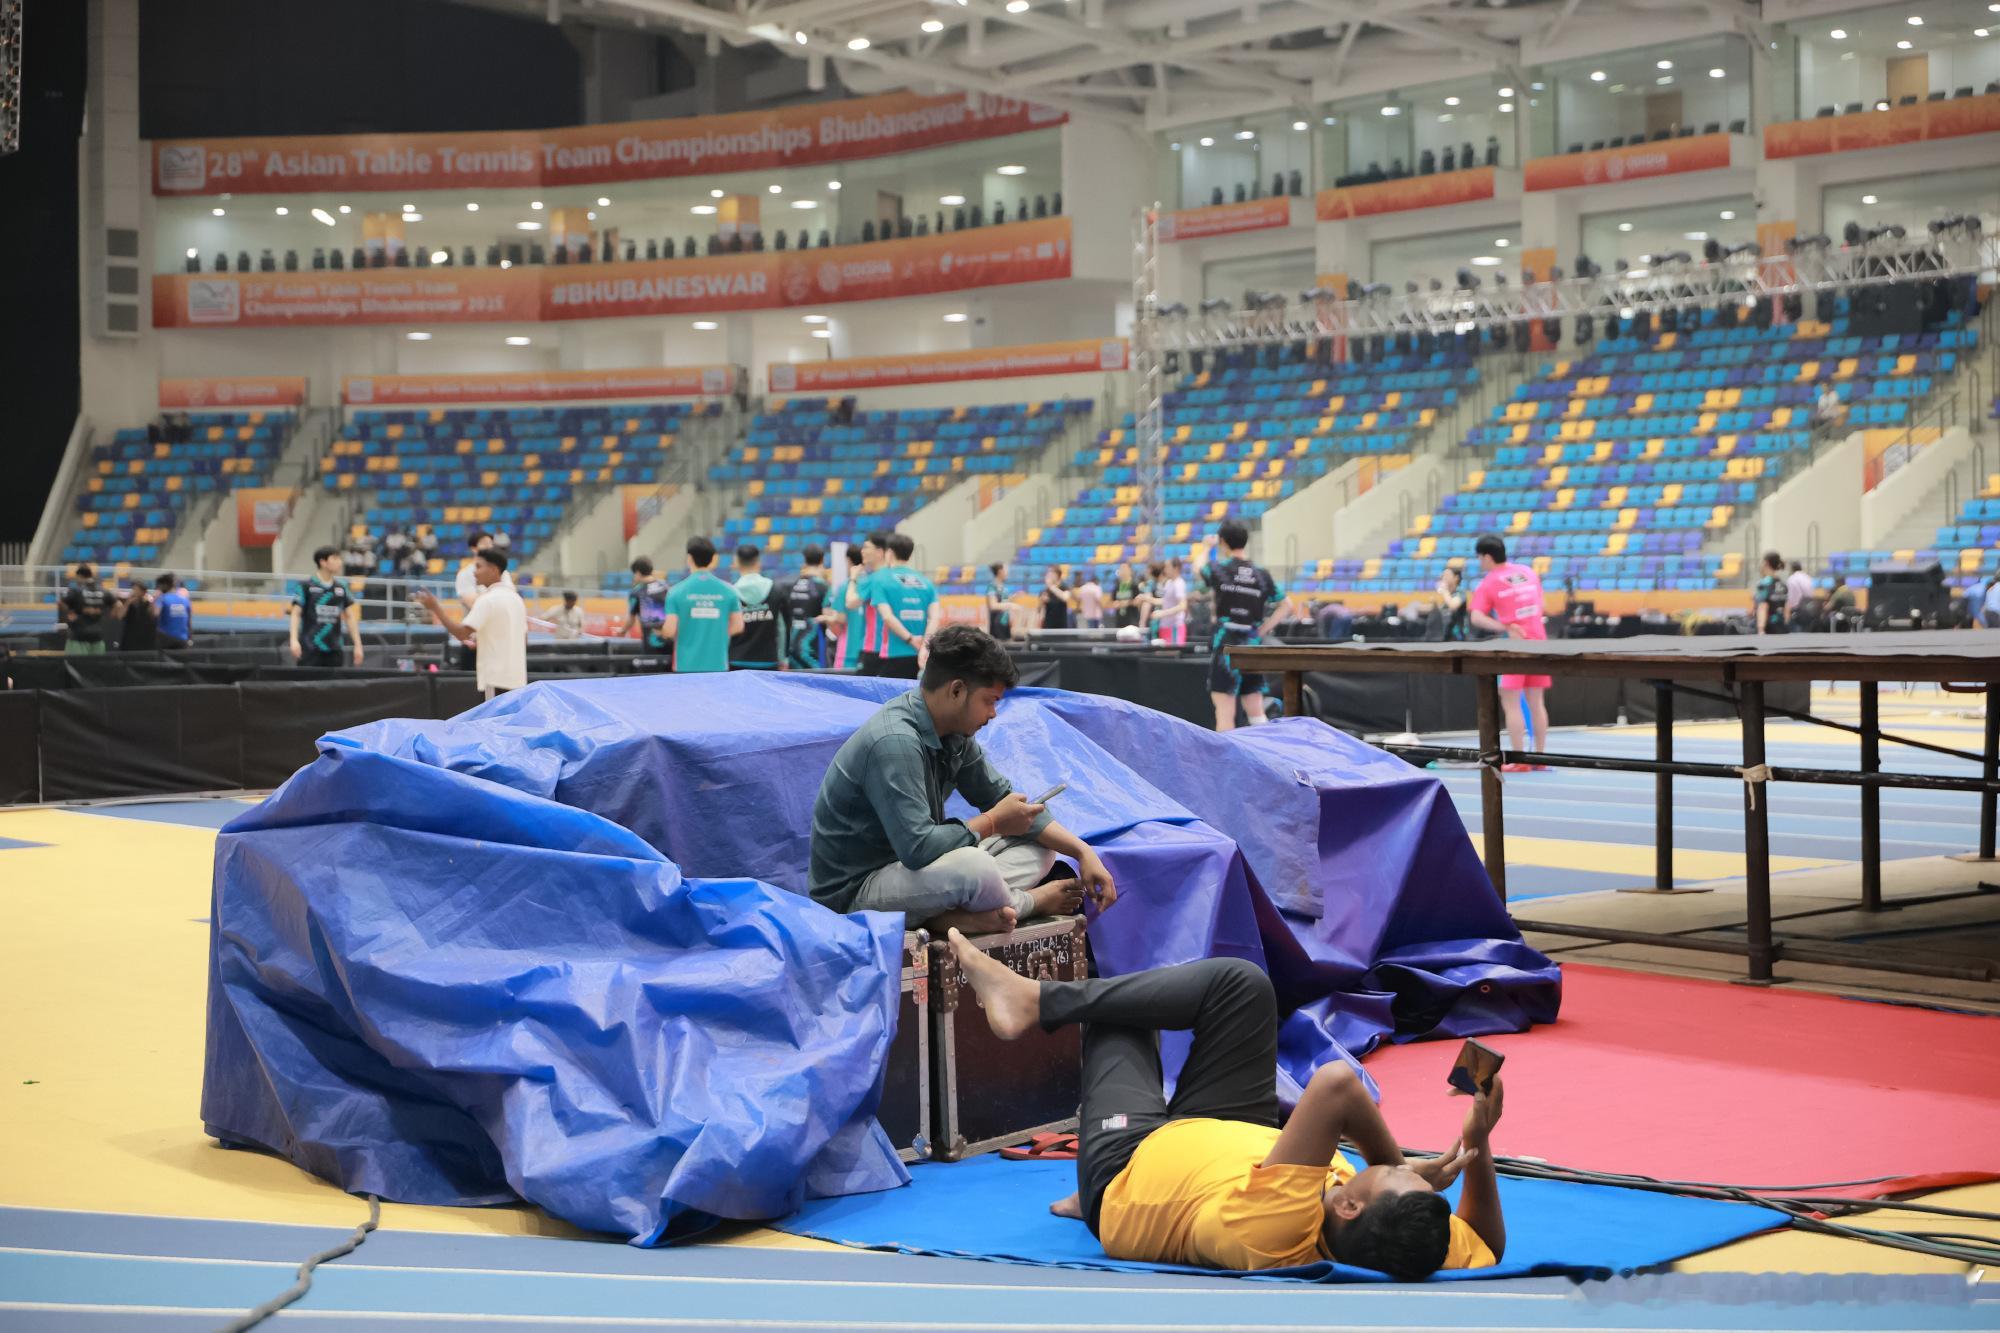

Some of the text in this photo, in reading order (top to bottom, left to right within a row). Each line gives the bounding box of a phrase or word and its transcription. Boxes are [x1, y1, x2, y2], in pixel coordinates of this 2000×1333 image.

[264, 150, 346, 177] Asian
[351, 147, 433, 175] Table
[438, 146, 534, 173] Tennis
[542, 143, 611, 170] Team
[615, 124, 811, 165] Championships
[819, 102, 966, 146] Bhubaneswar
[552, 272, 767, 305] #BHUBANESWAR
[742, 610, 774, 623] OREA
